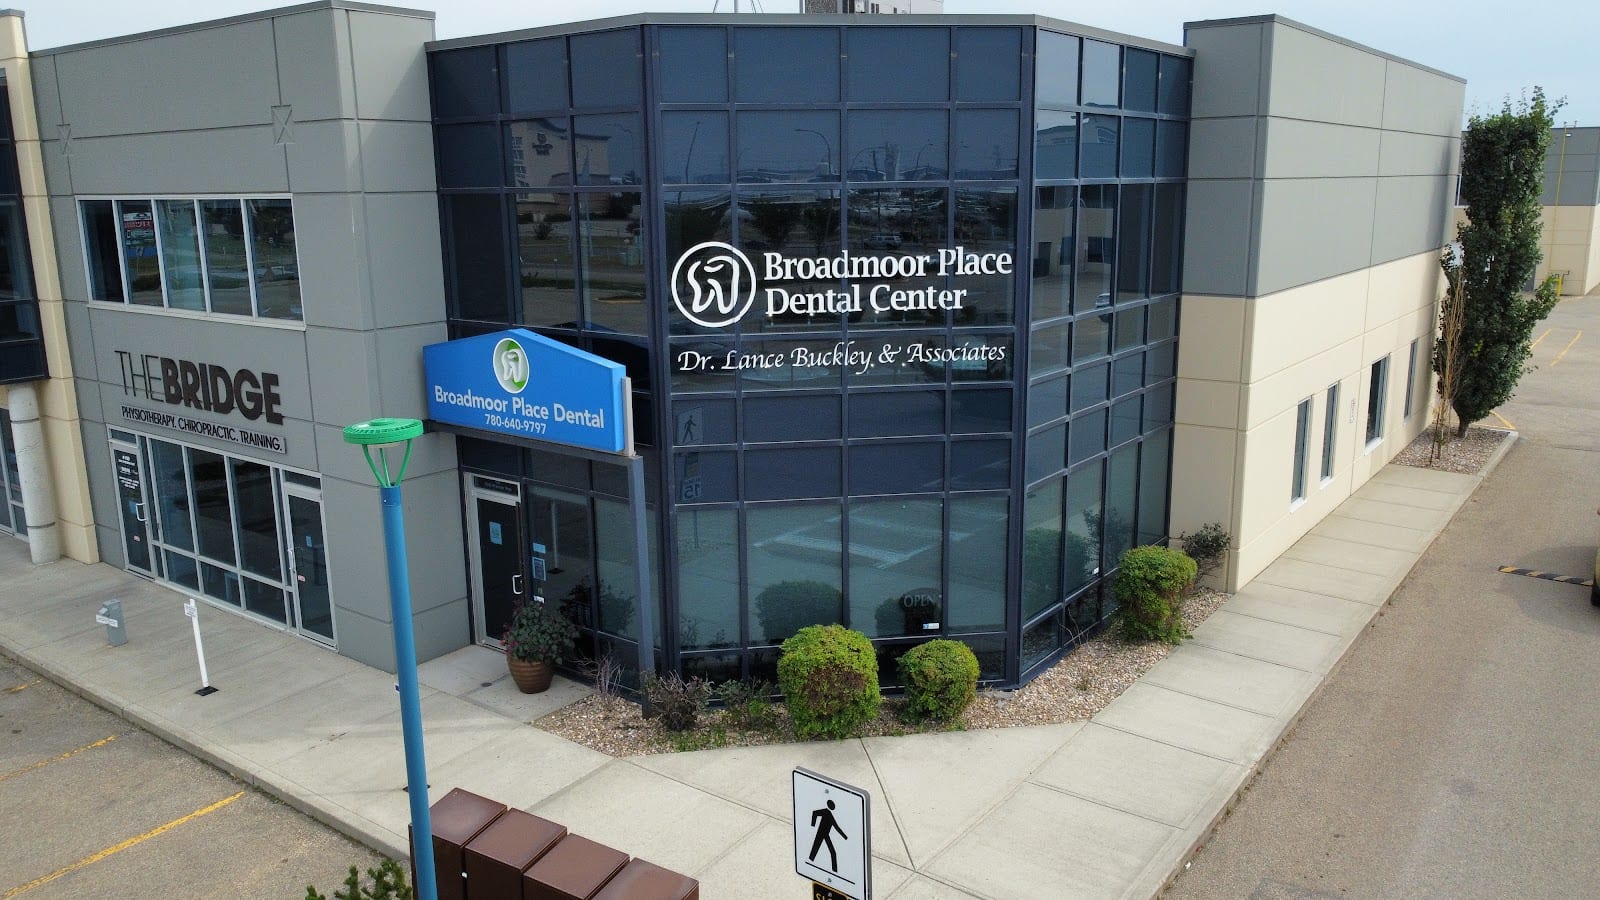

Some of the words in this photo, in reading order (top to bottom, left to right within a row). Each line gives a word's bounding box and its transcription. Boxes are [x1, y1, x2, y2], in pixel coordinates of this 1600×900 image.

[764, 250, 930, 281] Broadmoor
[938, 246, 1012, 277] Place
[765, 284, 862, 315] Dental
[870, 284, 967, 312] Center
[677, 350, 714, 372] Dr.
[721, 349, 784, 370] Lance
[791, 340, 873, 375] Buckley
[878, 344, 902, 364] &
[907, 341, 1006, 363] Associates
[434, 385, 508, 413] Broadmoor
[512, 397, 549, 420] Place
[553, 404, 605, 429] Dental
[485, 413, 547, 435] 780-640-9797
[903, 594, 936, 608] OPEN
